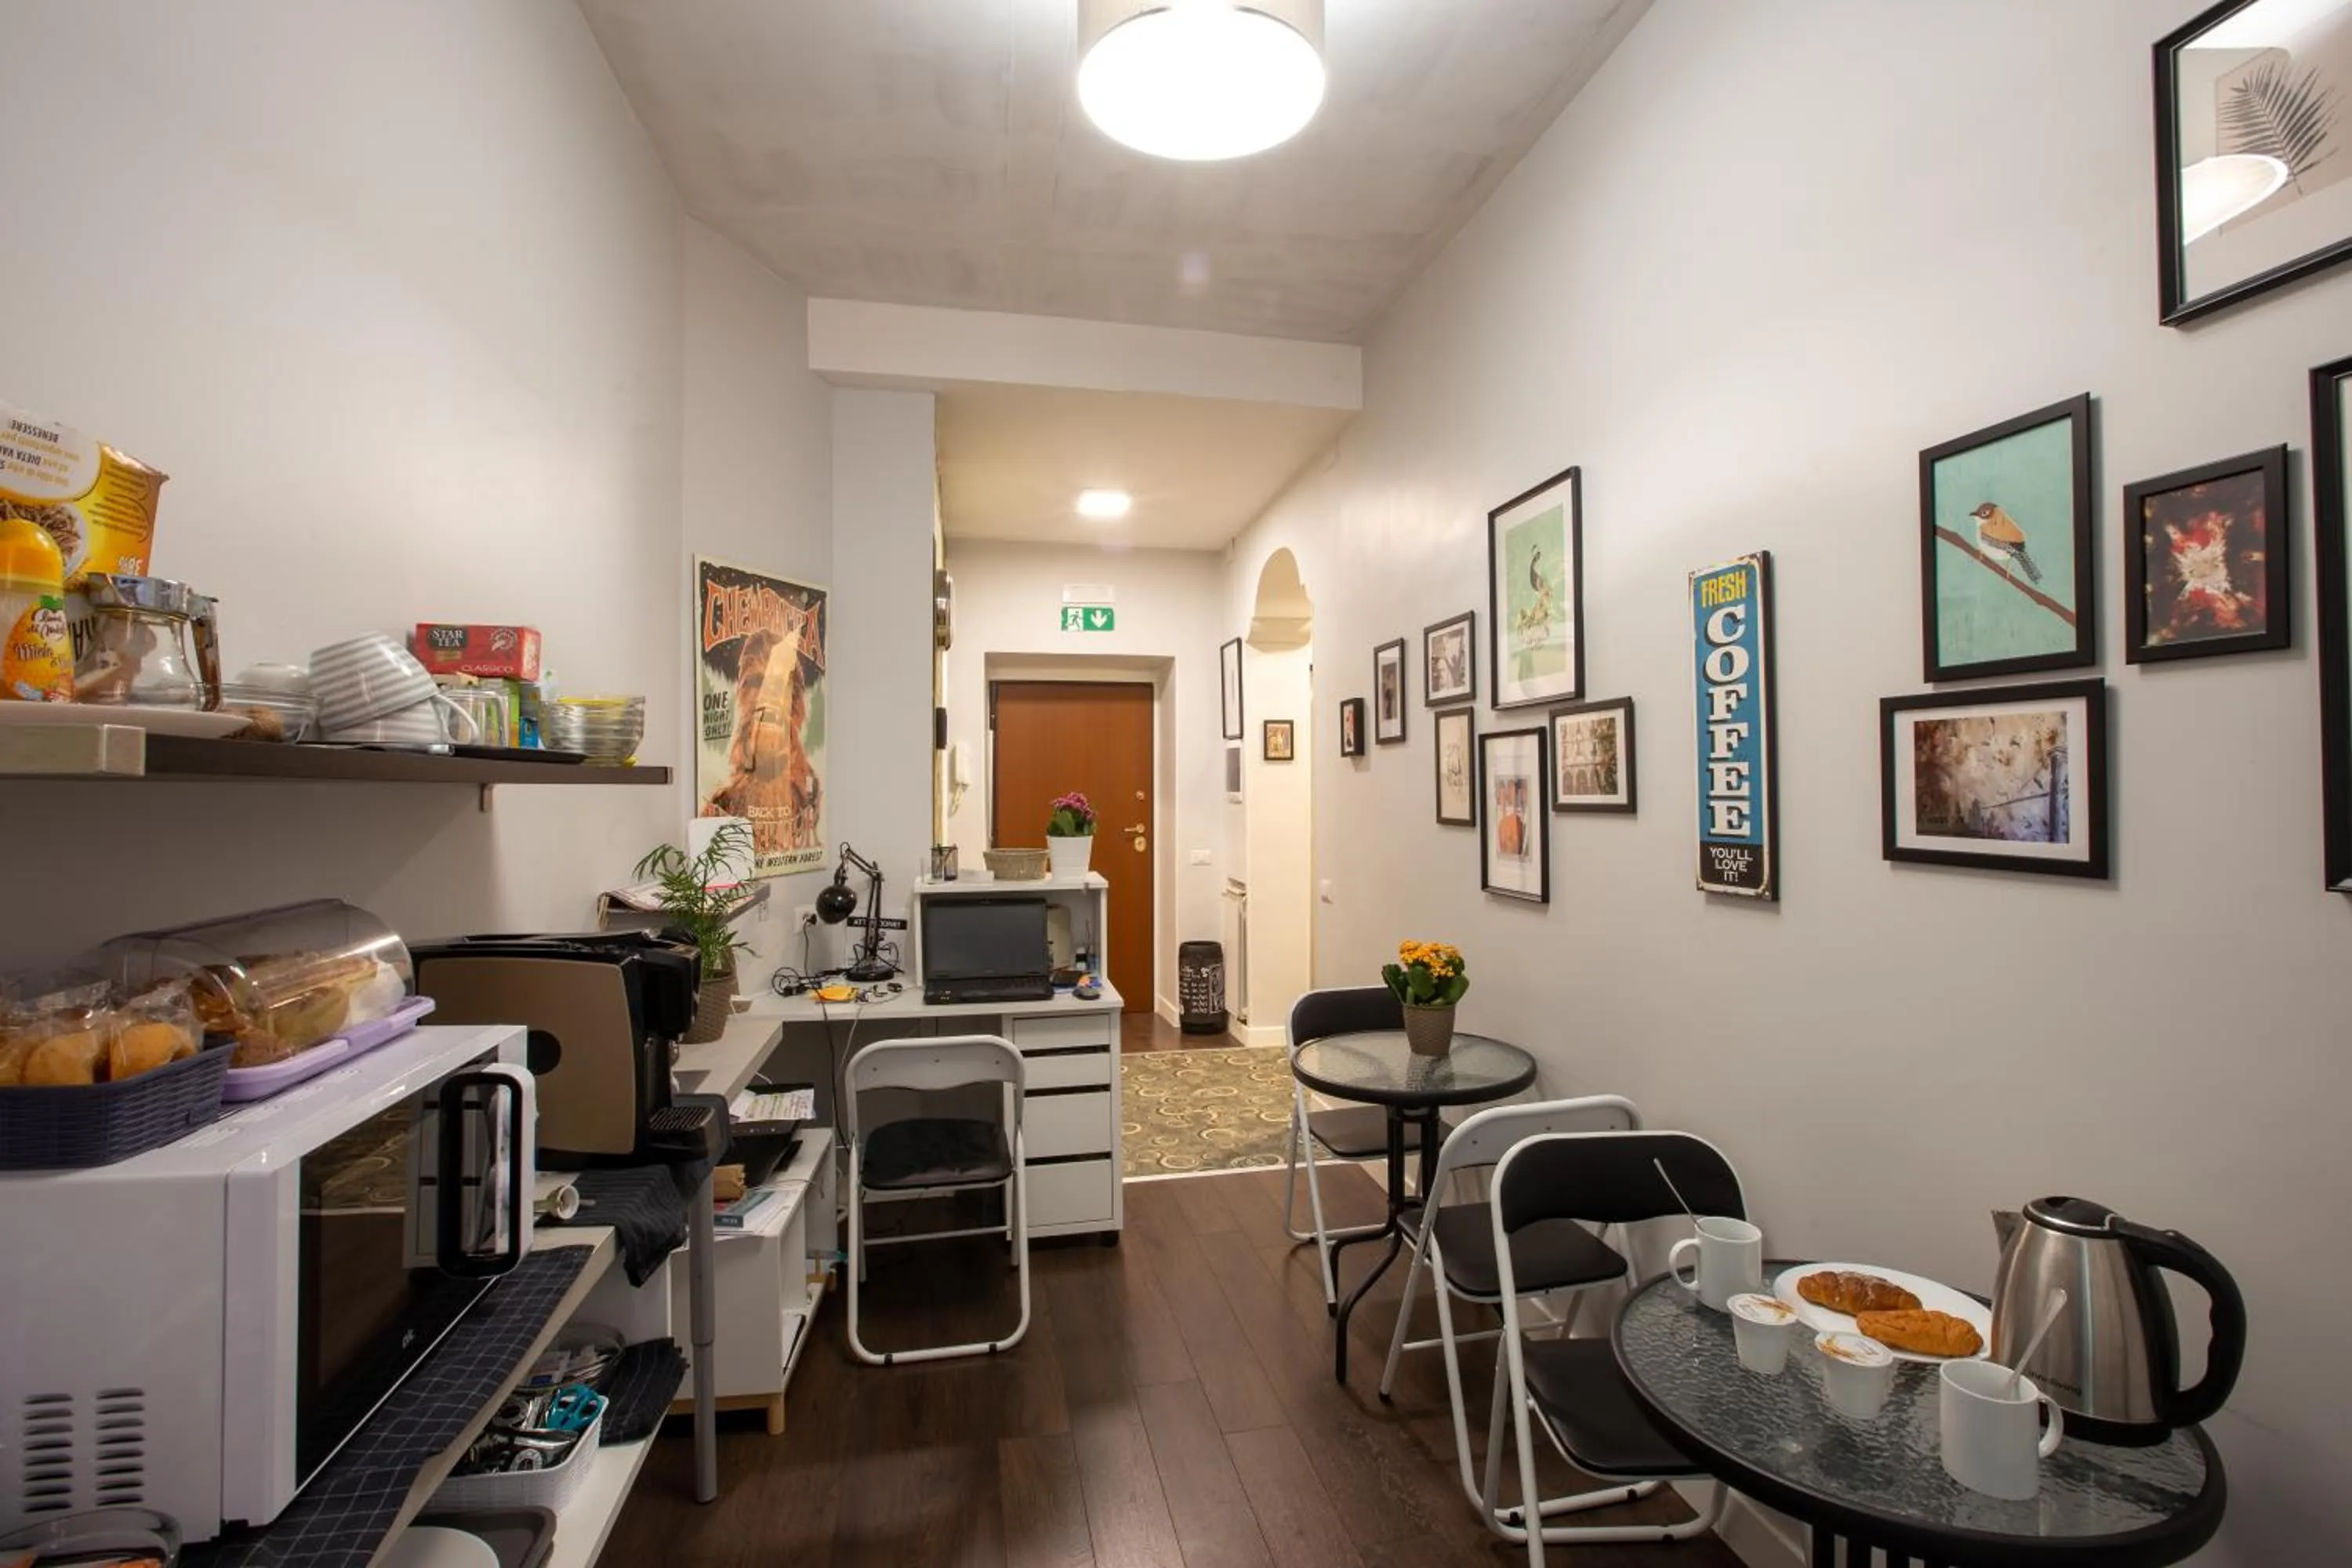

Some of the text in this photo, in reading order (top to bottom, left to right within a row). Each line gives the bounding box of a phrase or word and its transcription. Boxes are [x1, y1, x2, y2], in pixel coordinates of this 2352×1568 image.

[11, 419, 60, 443] BENESSERE
[16, 450, 42, 466] DIETA
[1700, 569, 1747, 608] FRESH
[432, 629, 463, 639] STAR
[437, 638, 460, 648] TEA
[703, 691, 728, 711] ONE
[704, 710, 729, 724] NIGHT
[1705, 604, 1751, 837] COFFEE
[748, 804, 791, 819] BACK TO
[767, 855, 797, 868] WESTERN
[799, 850, 822, 864] FOREST
[1710, 848, 1753, 862] YOU'LL
[1715, 858, 1747, 872] LOVE
[1724, 871, 1738, 882] IT!
